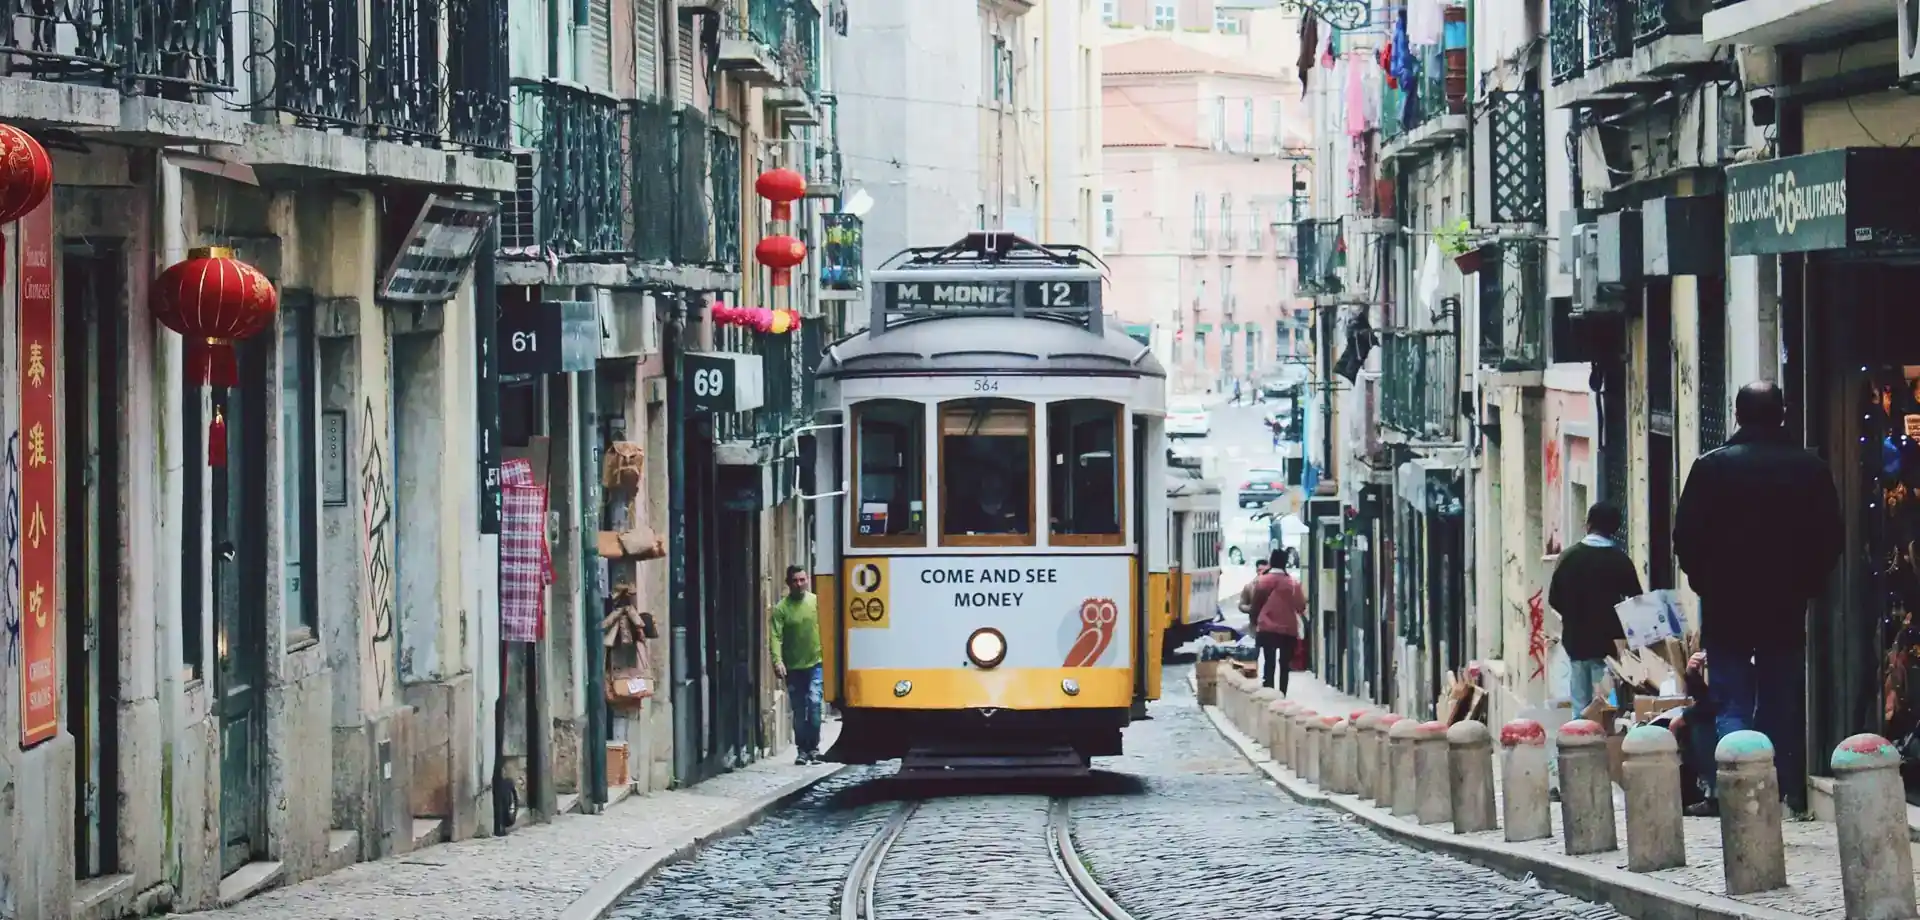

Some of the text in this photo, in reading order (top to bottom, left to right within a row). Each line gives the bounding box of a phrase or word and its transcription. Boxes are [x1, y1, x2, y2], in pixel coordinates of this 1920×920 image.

[1775, 169, 1797, 235] 56
[1795, 179, 1846, 221] BIJUTARIAS
[897, 283, 1011, 303] M. MONIZ
[1039, 282, 1071, 306] 12
[511, 331, 537, 352] 61
[694, 368, 723, 397] 69
[974, 379, 999, 391] 564
[920, 568, 1057, 584] COME AND SEE
[954, 592, 1024, 607] MONEY
